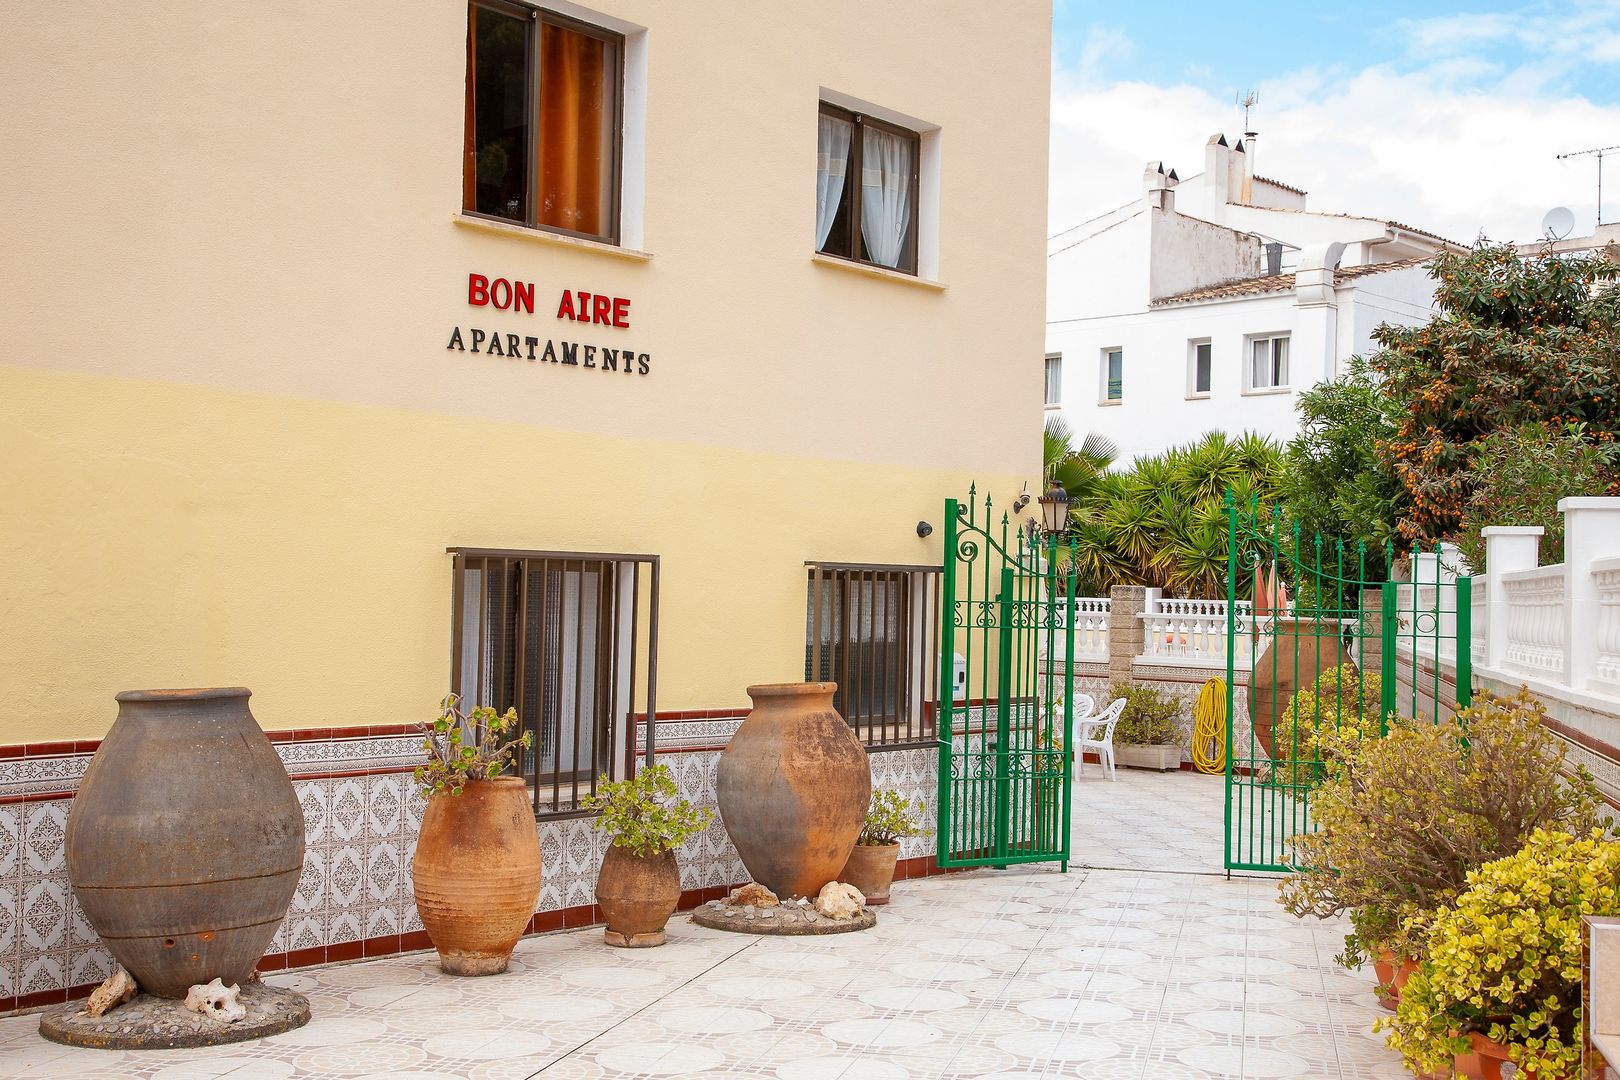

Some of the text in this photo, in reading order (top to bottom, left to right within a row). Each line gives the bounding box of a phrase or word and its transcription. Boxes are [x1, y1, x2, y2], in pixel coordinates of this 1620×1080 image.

[468, 273, 631, 328] BON AIRE
[447, 326, 650, 375] APARTAMENTS
